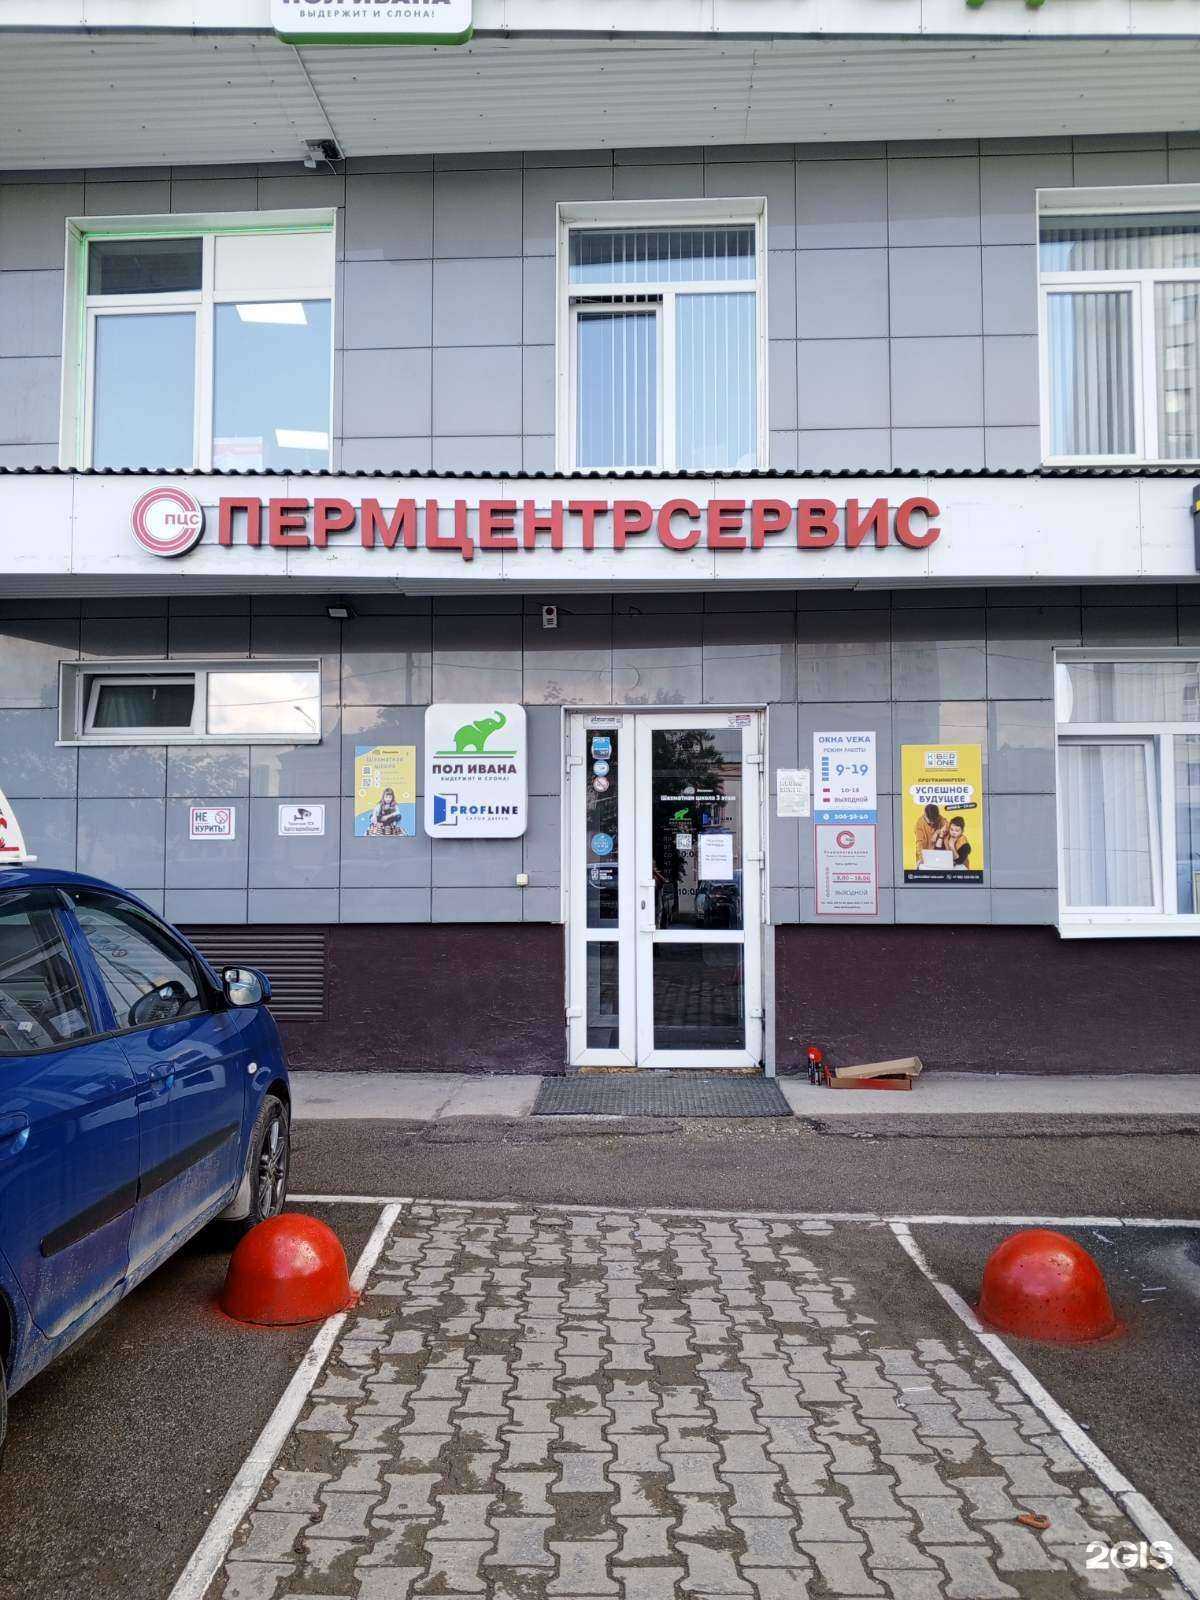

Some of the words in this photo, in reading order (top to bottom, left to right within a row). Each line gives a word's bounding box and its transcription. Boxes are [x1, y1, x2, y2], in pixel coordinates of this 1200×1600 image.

[299, 10, 367, 18] ВЫДЕРЖИТ
[386, 10, 435, 18] СЛОНА!
[165, 513, 199, 526] ПЦС
[218, 496, 941, 561] ПЕРМЦЕНТРСЕРВИС
[432, 763, 464, 774] ПОЛ
[467, 763, 517, 774] ИВАНА
[835, 763, 869, 776] 9-19
[915, 786, 969, 794] УСПЕШНОЕ
[919, 795, 966, 803] БУДУЩЕЕ
[450, 805, 519, 815] PROFLINE
[195, 811, 207, 822] НЕ
[195, 825, 225, 833] КУРИТЬ!
